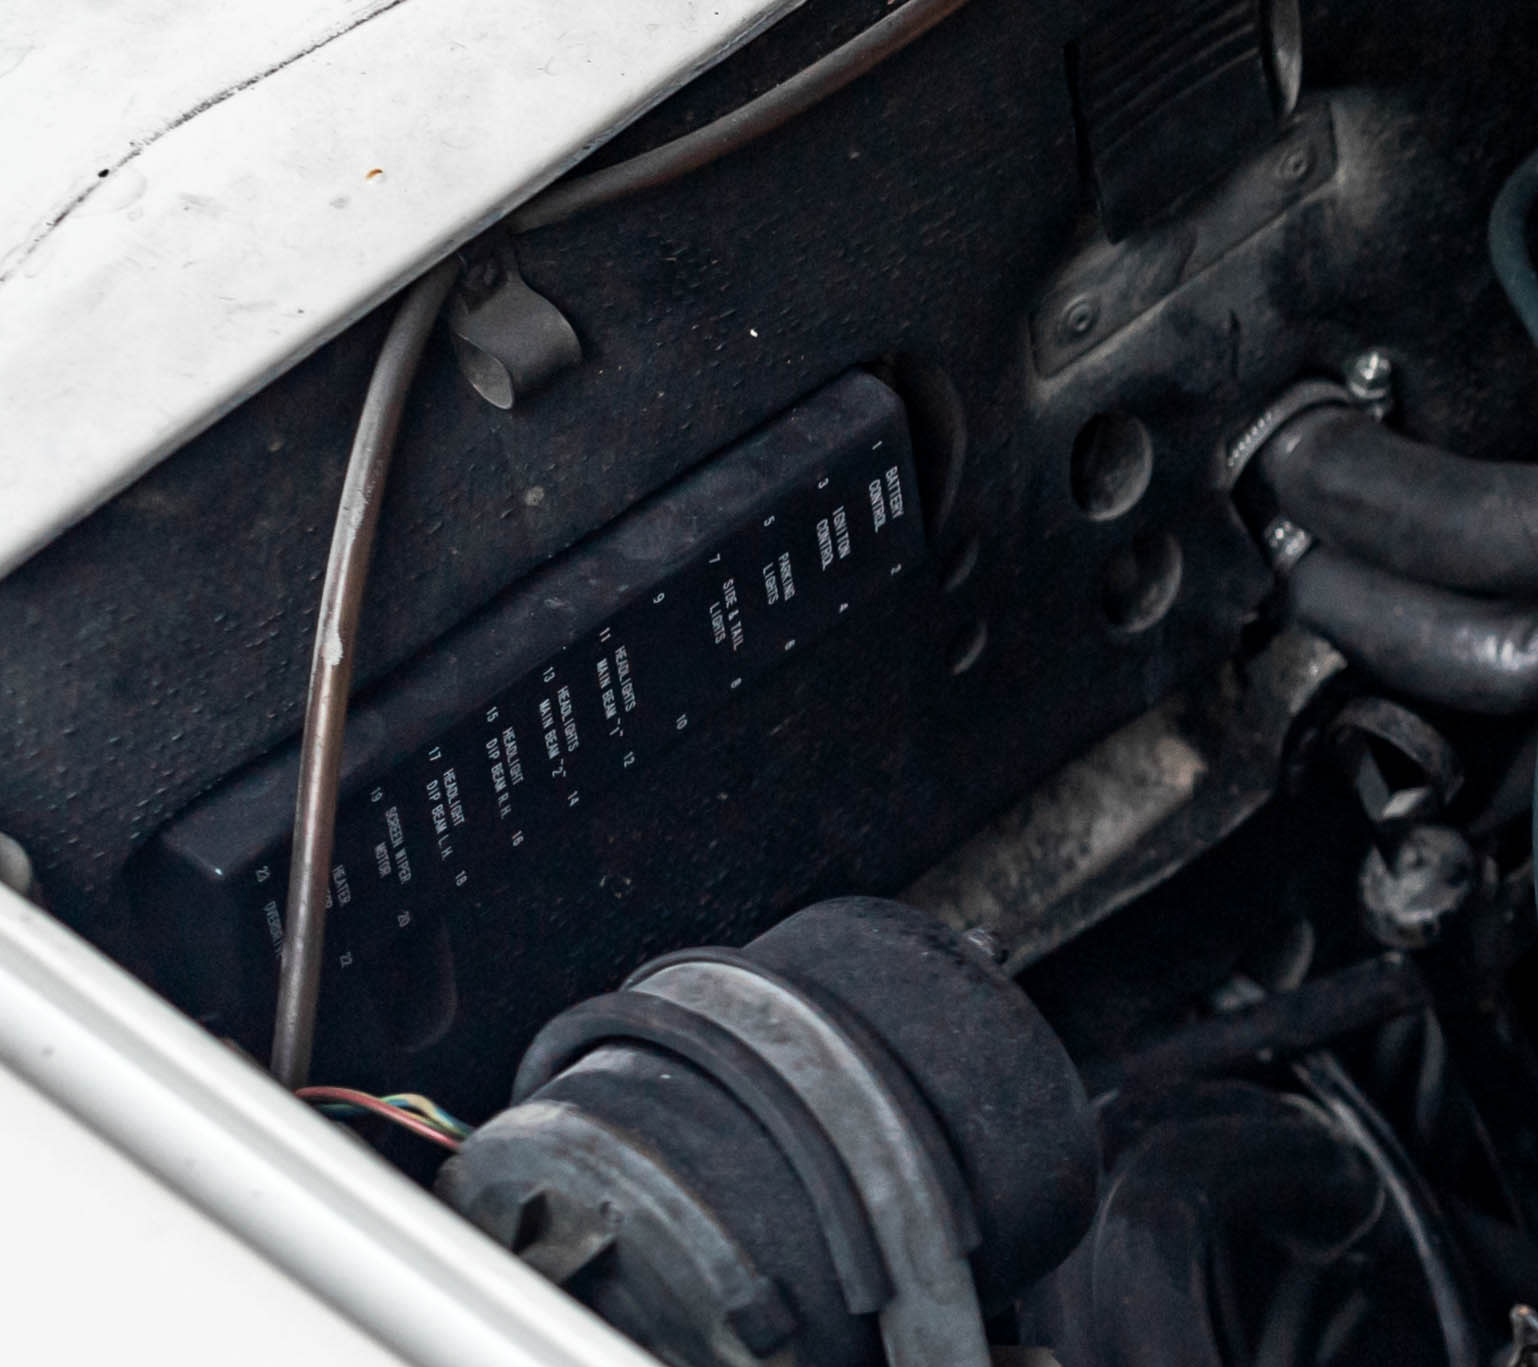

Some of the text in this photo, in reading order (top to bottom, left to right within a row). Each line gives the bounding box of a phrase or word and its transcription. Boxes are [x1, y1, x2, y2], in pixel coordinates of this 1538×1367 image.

[818, 478, 829, 489] 3
[886, 466, 904, 518] BATTERY
[764, 516, 775, 526] 5
[869, 479, 886, 533] CONTROL
[709, 553, 720, 563] 7
[816, 519, 833, 571] CONTROL
[763, 563, 779, 605] LIGHTS
[779, 552, 795, 600] PARKING
[653, 593, 664, 603] 9
[709, 602, 726, 644] LIGHTS
[723, 579, 737, 608] SIDE
[731, 621, 743, 650] TAIL
[600, 627, 611, 642] 11
[543, 667, 555, 682] 13
[597, 658, 610, 688] MAIN
[615, 645, 636, 712] HEADLIGHTS
[487, 706, 498, 722] 15
[539, 699, 553, 729] MAIN
[557, 686, 579, 752] HEADLIGHTS
[602, 689, 616, 719] BEAM
[676, 714, 687, 730] 10
[429, 747, 441, 761] 17
[486, 738, 500, 759] DIP
[502, 727, 524, 785] HEADLIGHT
[545, 729, 560, 759] BEAM
[624, 752, 635, 768] 12
[426, 780, 441, 800] DIP
[491, 762, 506, 792] BEAM
[371, 787, 383, 802] 19
[443, 768, 464, 826] HEADLIGHT
[568, 791, 579, 806] 14
[432, 804, 447, 834] BEAM
[385, 806, 411, 884] SCREEN WIPER
[512, 830, 524, 846] 16
[375, 842, 391, 877] MOTOR
[332, 865, 351, 906] HEATER
[456, 870, 467, 886] 18
